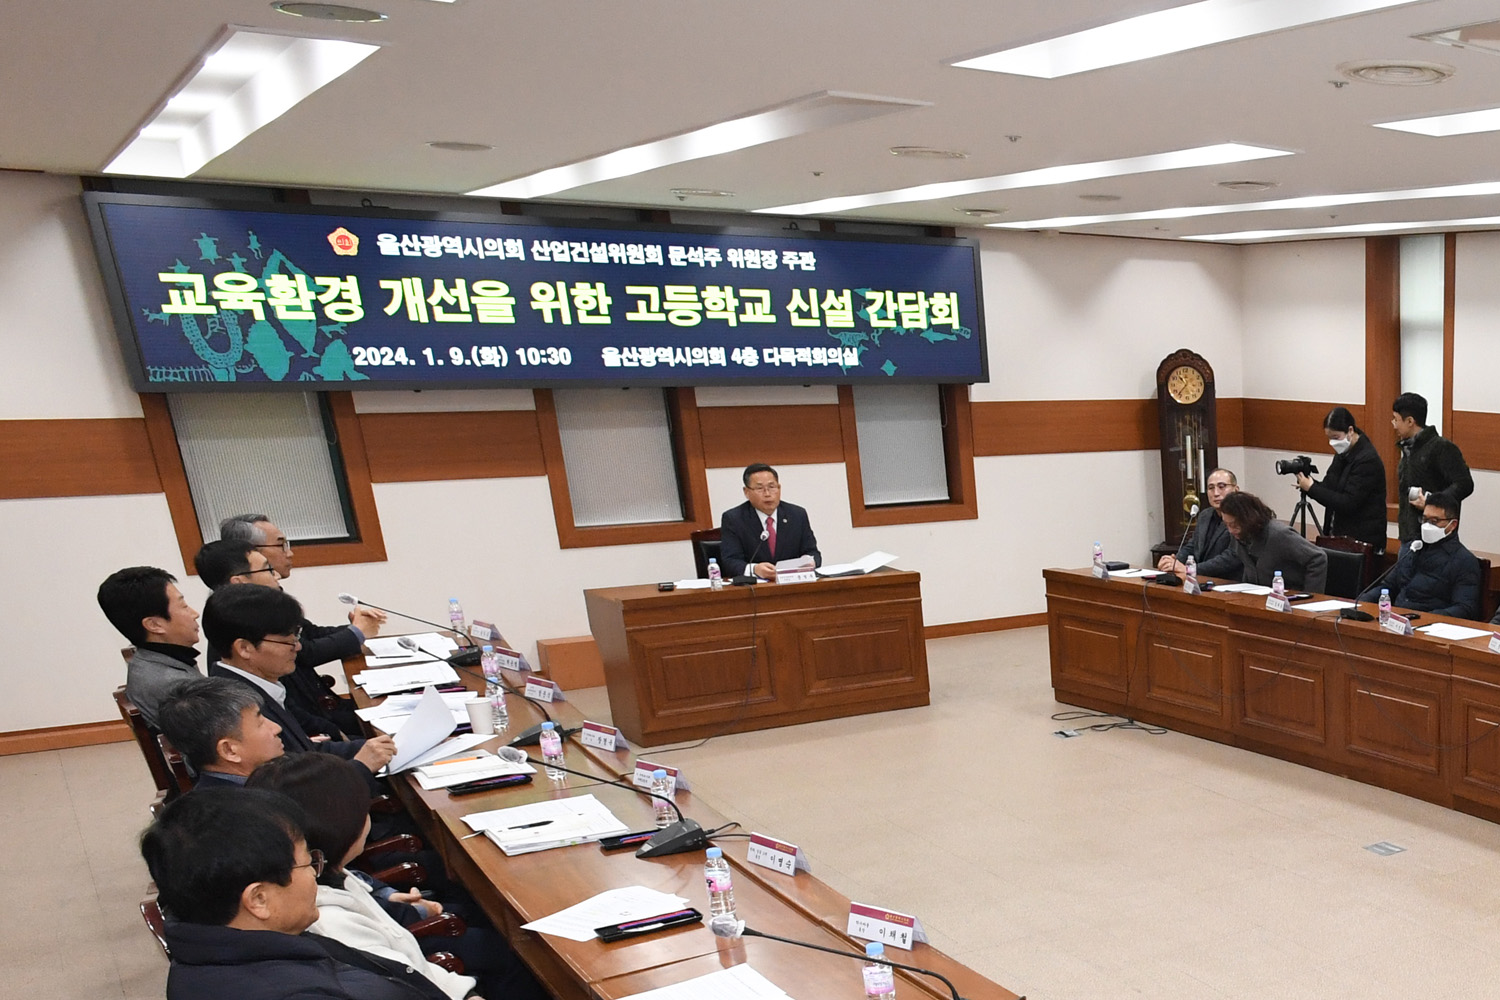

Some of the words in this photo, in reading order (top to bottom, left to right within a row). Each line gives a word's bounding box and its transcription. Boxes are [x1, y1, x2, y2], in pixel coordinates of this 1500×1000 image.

[377, 234, 525, 260] 울산광역시의회
[531, 240, 664, 265] 산업건설위원회
[668, 246, 722, 268] 문석주
[727, 249, 778, 270] 위원장
[782, 251, 816, 271] 주관
[158, 271, 364, 322] 교육환경
[379, 277, 516, 324] 개선을
[530, 281, 612, 325] 위한
[625, 285, 777, 327] 고등학교
[786, 288, 855, 327] 신설
[865, 290, 960, 330] 간담회
[353, 346, 415, 366] 2024.
[422, 347, 444, 366] 1.
[516, 347, 572, 366] 10:30
[601, 346, 727, 367] 울산광역시의회
[731, 347, 760, 367] 4층
[763, 346, 860, 367] 다목적회의실
